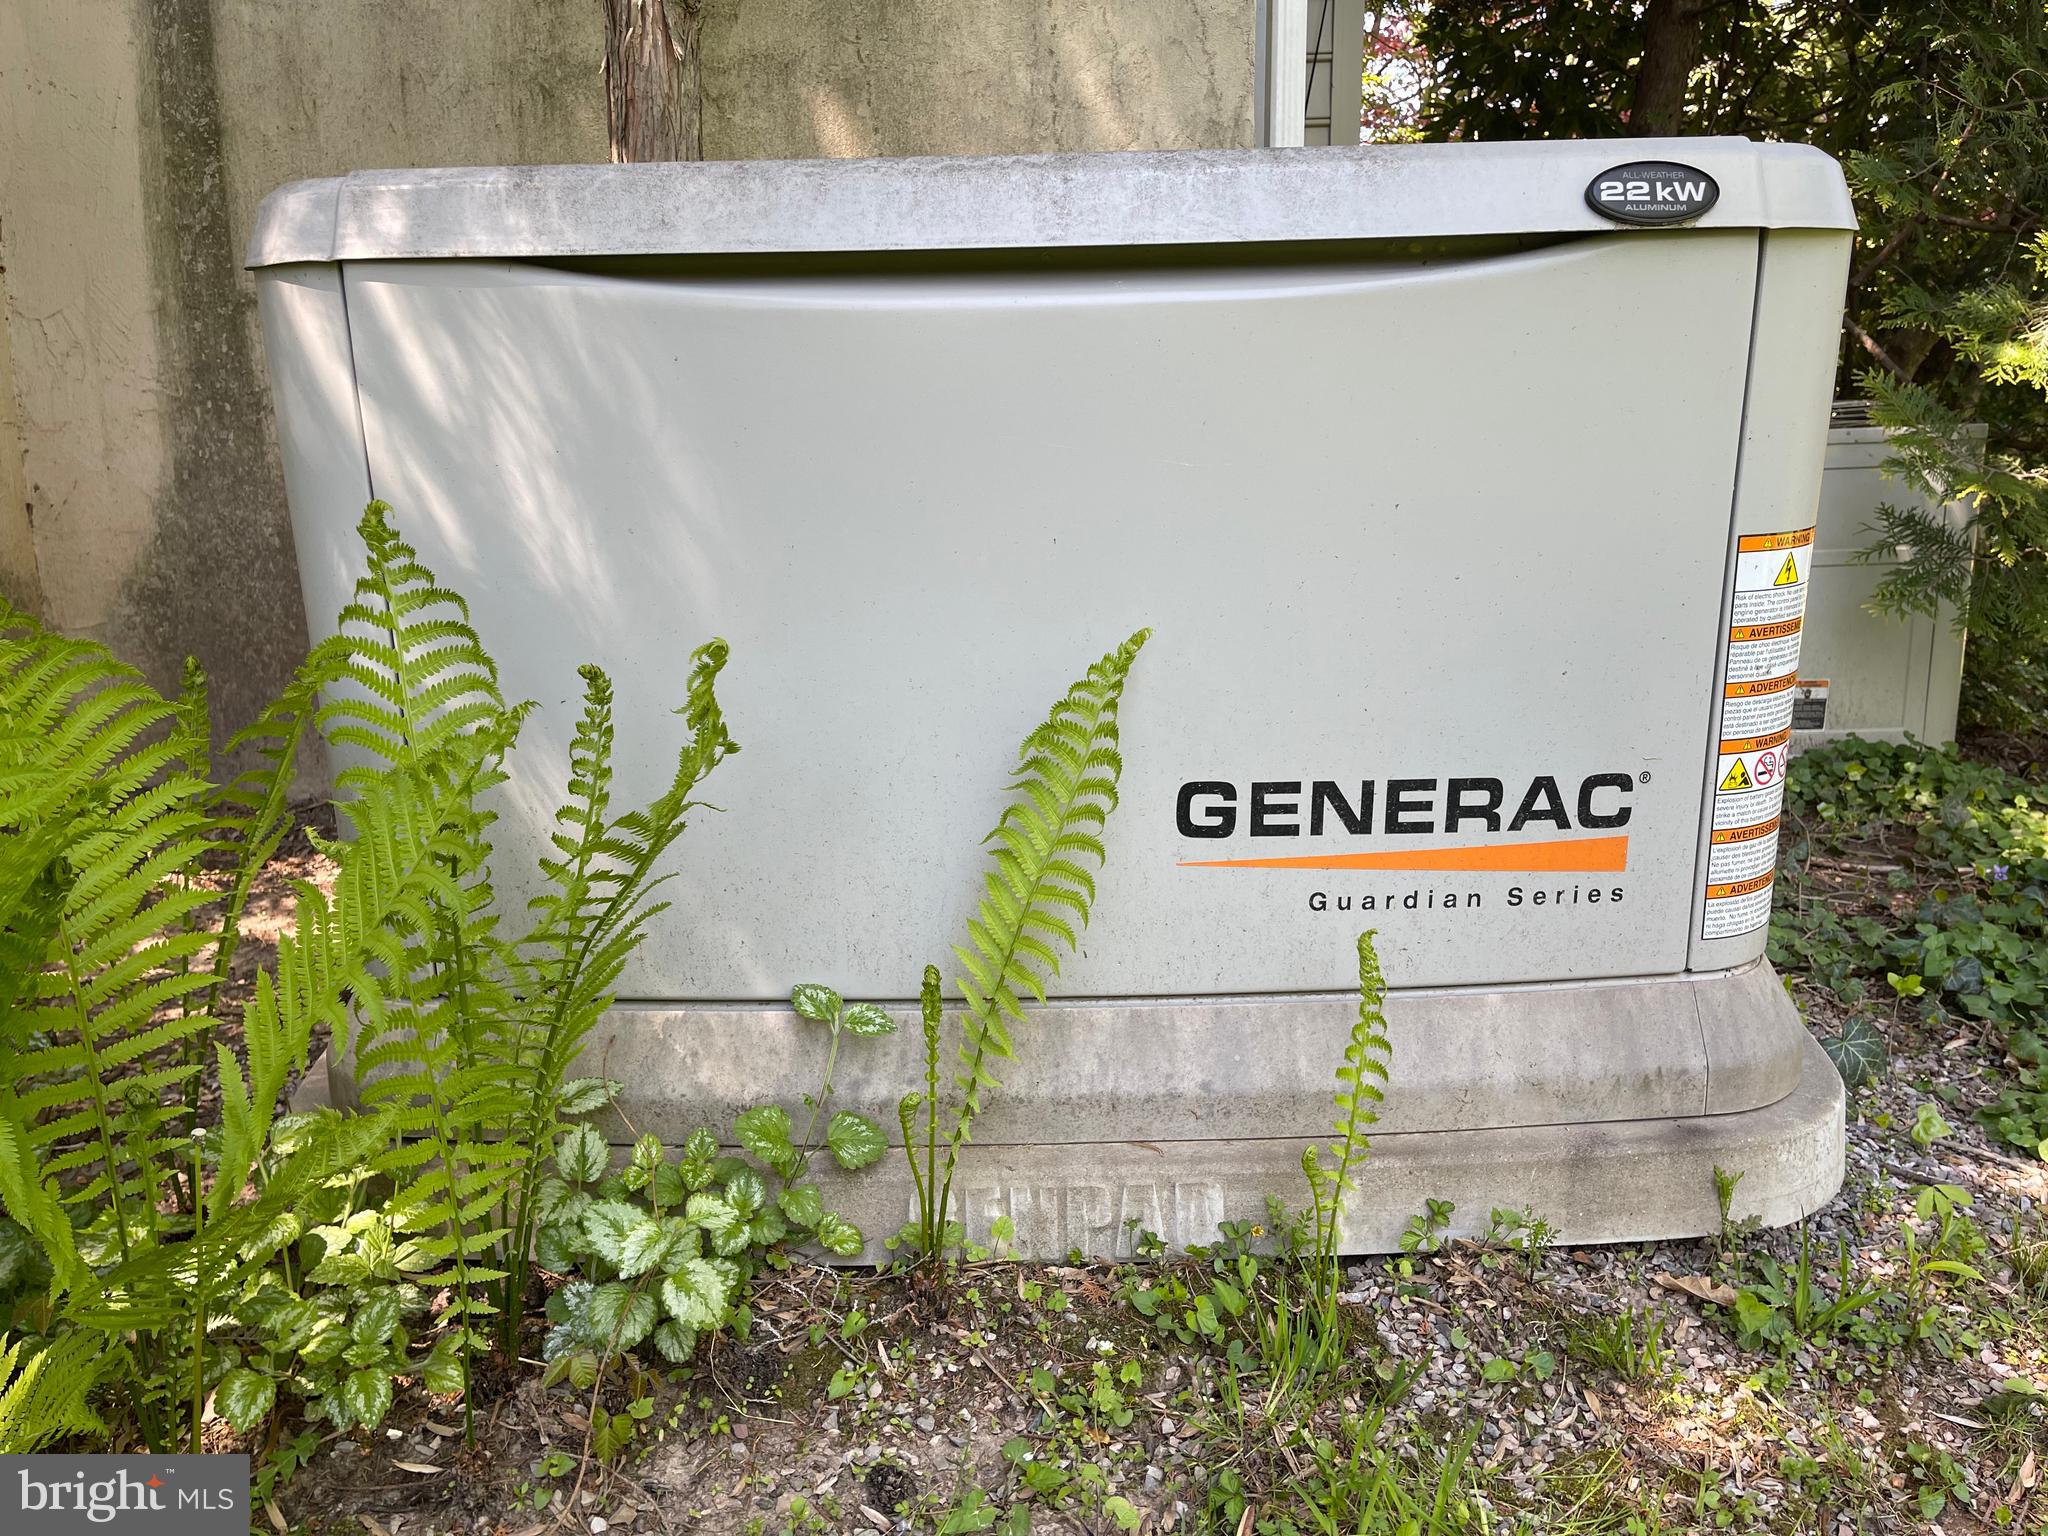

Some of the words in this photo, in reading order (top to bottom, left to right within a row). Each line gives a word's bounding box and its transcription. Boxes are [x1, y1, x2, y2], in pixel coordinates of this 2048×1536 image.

[1622, 171, 1685, 179] ALL-WEATHER
[1599, 181, 1651, 201] 22
[1655, 181, 1708, 202] kW
[1624, 203, 1688, 211] ALUMINUM
[1776, 532, 1811, 547] WARNING
[1175, 772, 1634, 839] GENERAC
[1309, 890, 1482, 912] Guardian
[1507, 886, 1624, 907] Series
